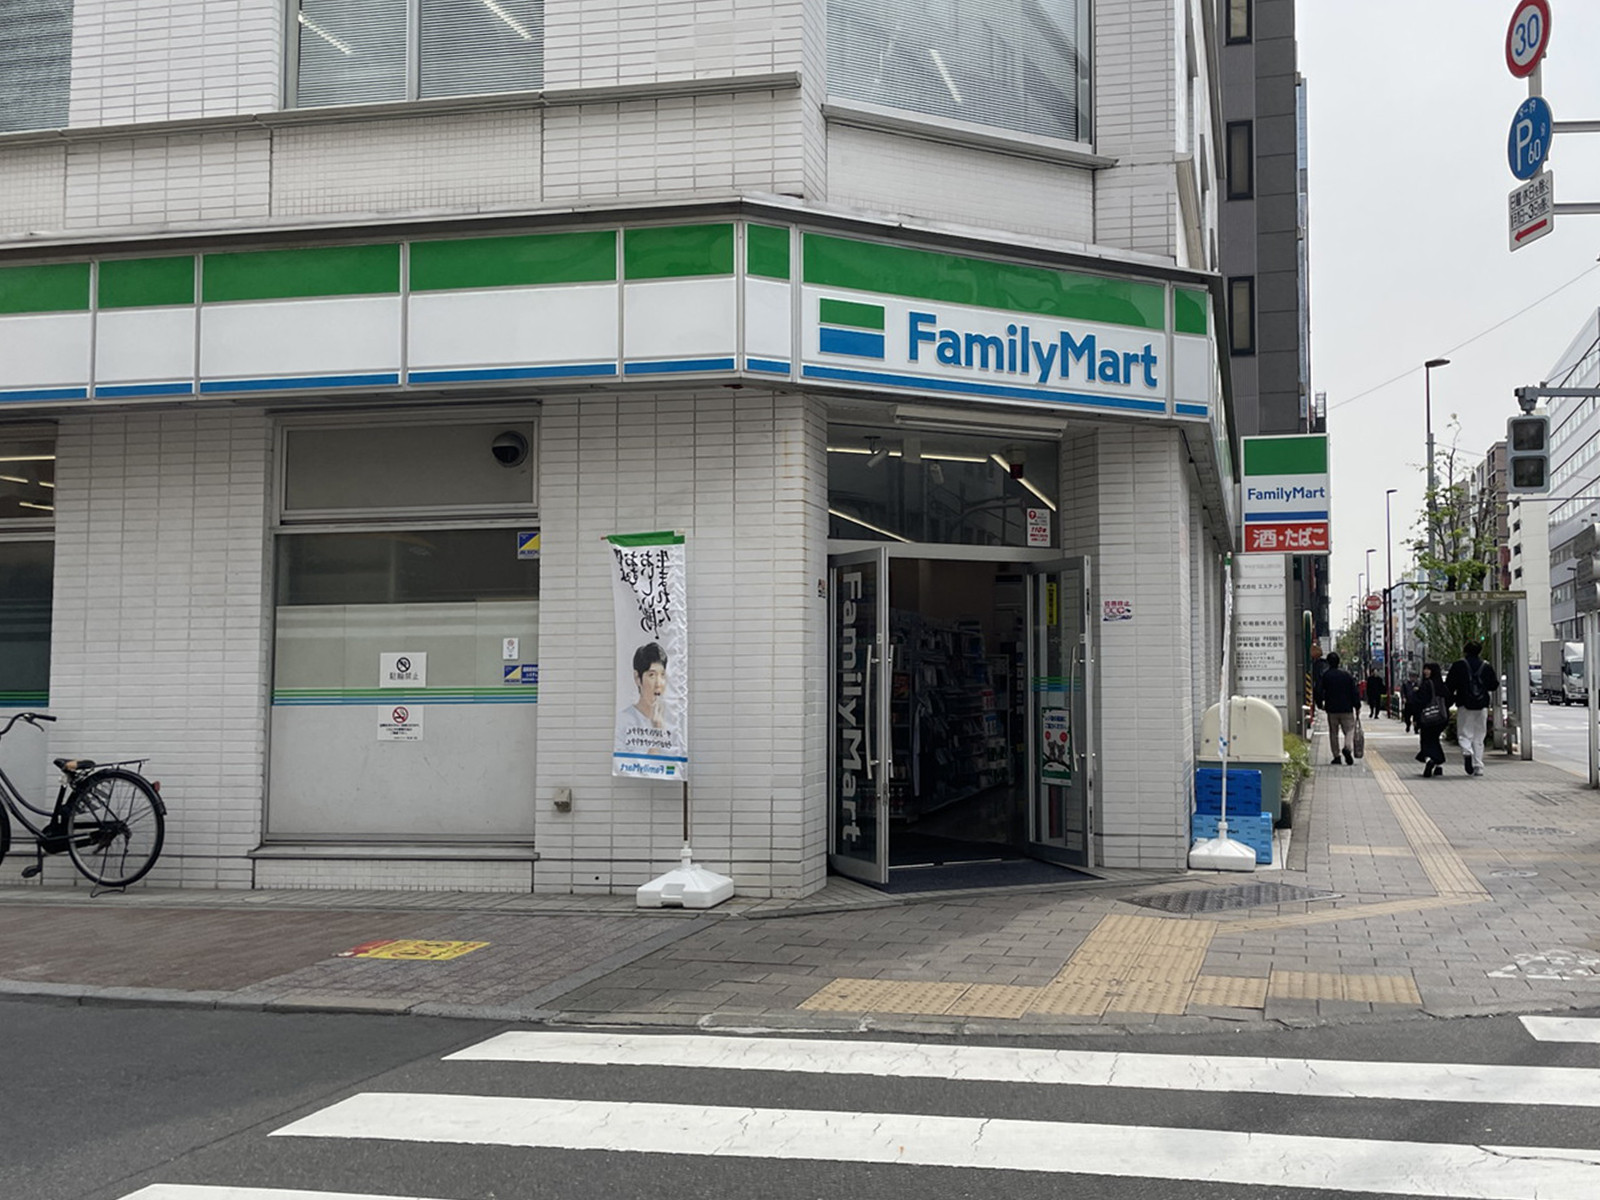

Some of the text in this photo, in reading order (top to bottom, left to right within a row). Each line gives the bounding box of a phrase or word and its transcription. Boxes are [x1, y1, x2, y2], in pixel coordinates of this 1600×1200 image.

[1515, 13, 1540, 57] 30
[1516, 118, 1533, 172] P
[907, 310, 1159, 389] FamilyMart
[1247, 486, 1326, 502] FamilyMart
[1252, 526, 1326, 548] 酒・たばこ
[837, 571, 862, 843] FamilyMart
